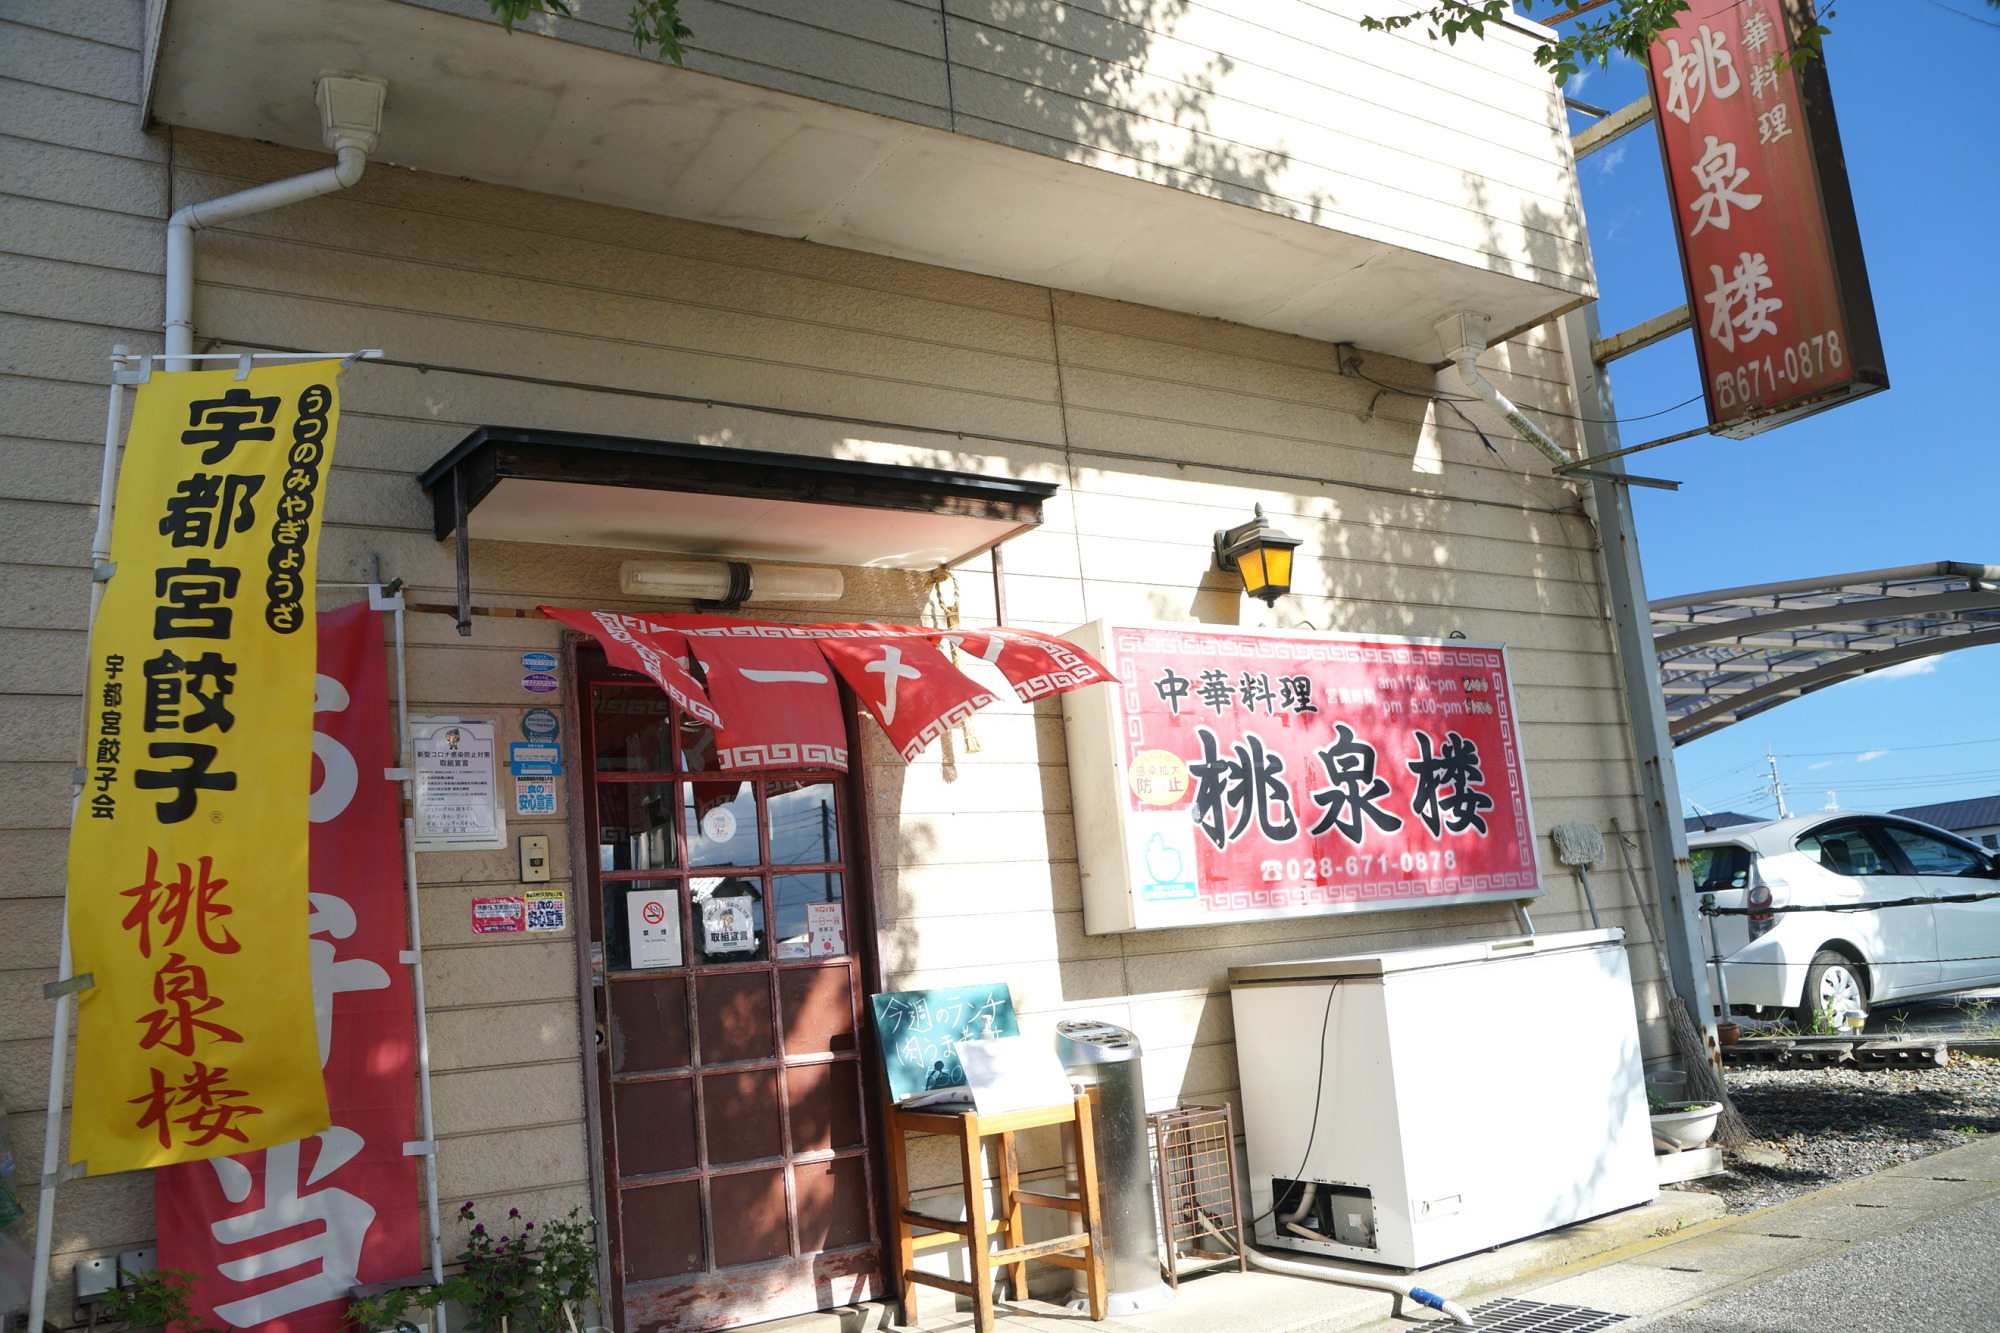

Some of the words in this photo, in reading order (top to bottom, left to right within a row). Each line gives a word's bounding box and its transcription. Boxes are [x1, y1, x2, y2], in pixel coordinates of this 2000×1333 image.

[1731, 0, 1793, 145] 華料理
[1663, 24, 1783, 353] 桃泉楼
[1736, 330, 1843, 402] 671-0878
[269, 387, 329, 631] うつのみやぎょうざ
[134, 389, 281, 824] 宇都宮餃子
[91, 653, 124, 820] 宇都宮餃子会
[1154, 668, 1318, 715] 中華料理
[1136, 764, 1181, 776] 感染拡大
[1188, 724, 1494, 850] 桃泉楼
[1286, 850, 1457, 881] 028-671-0878
[119, 846, 264, 1149] 桃泉楼
[880, 992, 1006, 1034] 今週のランチ
